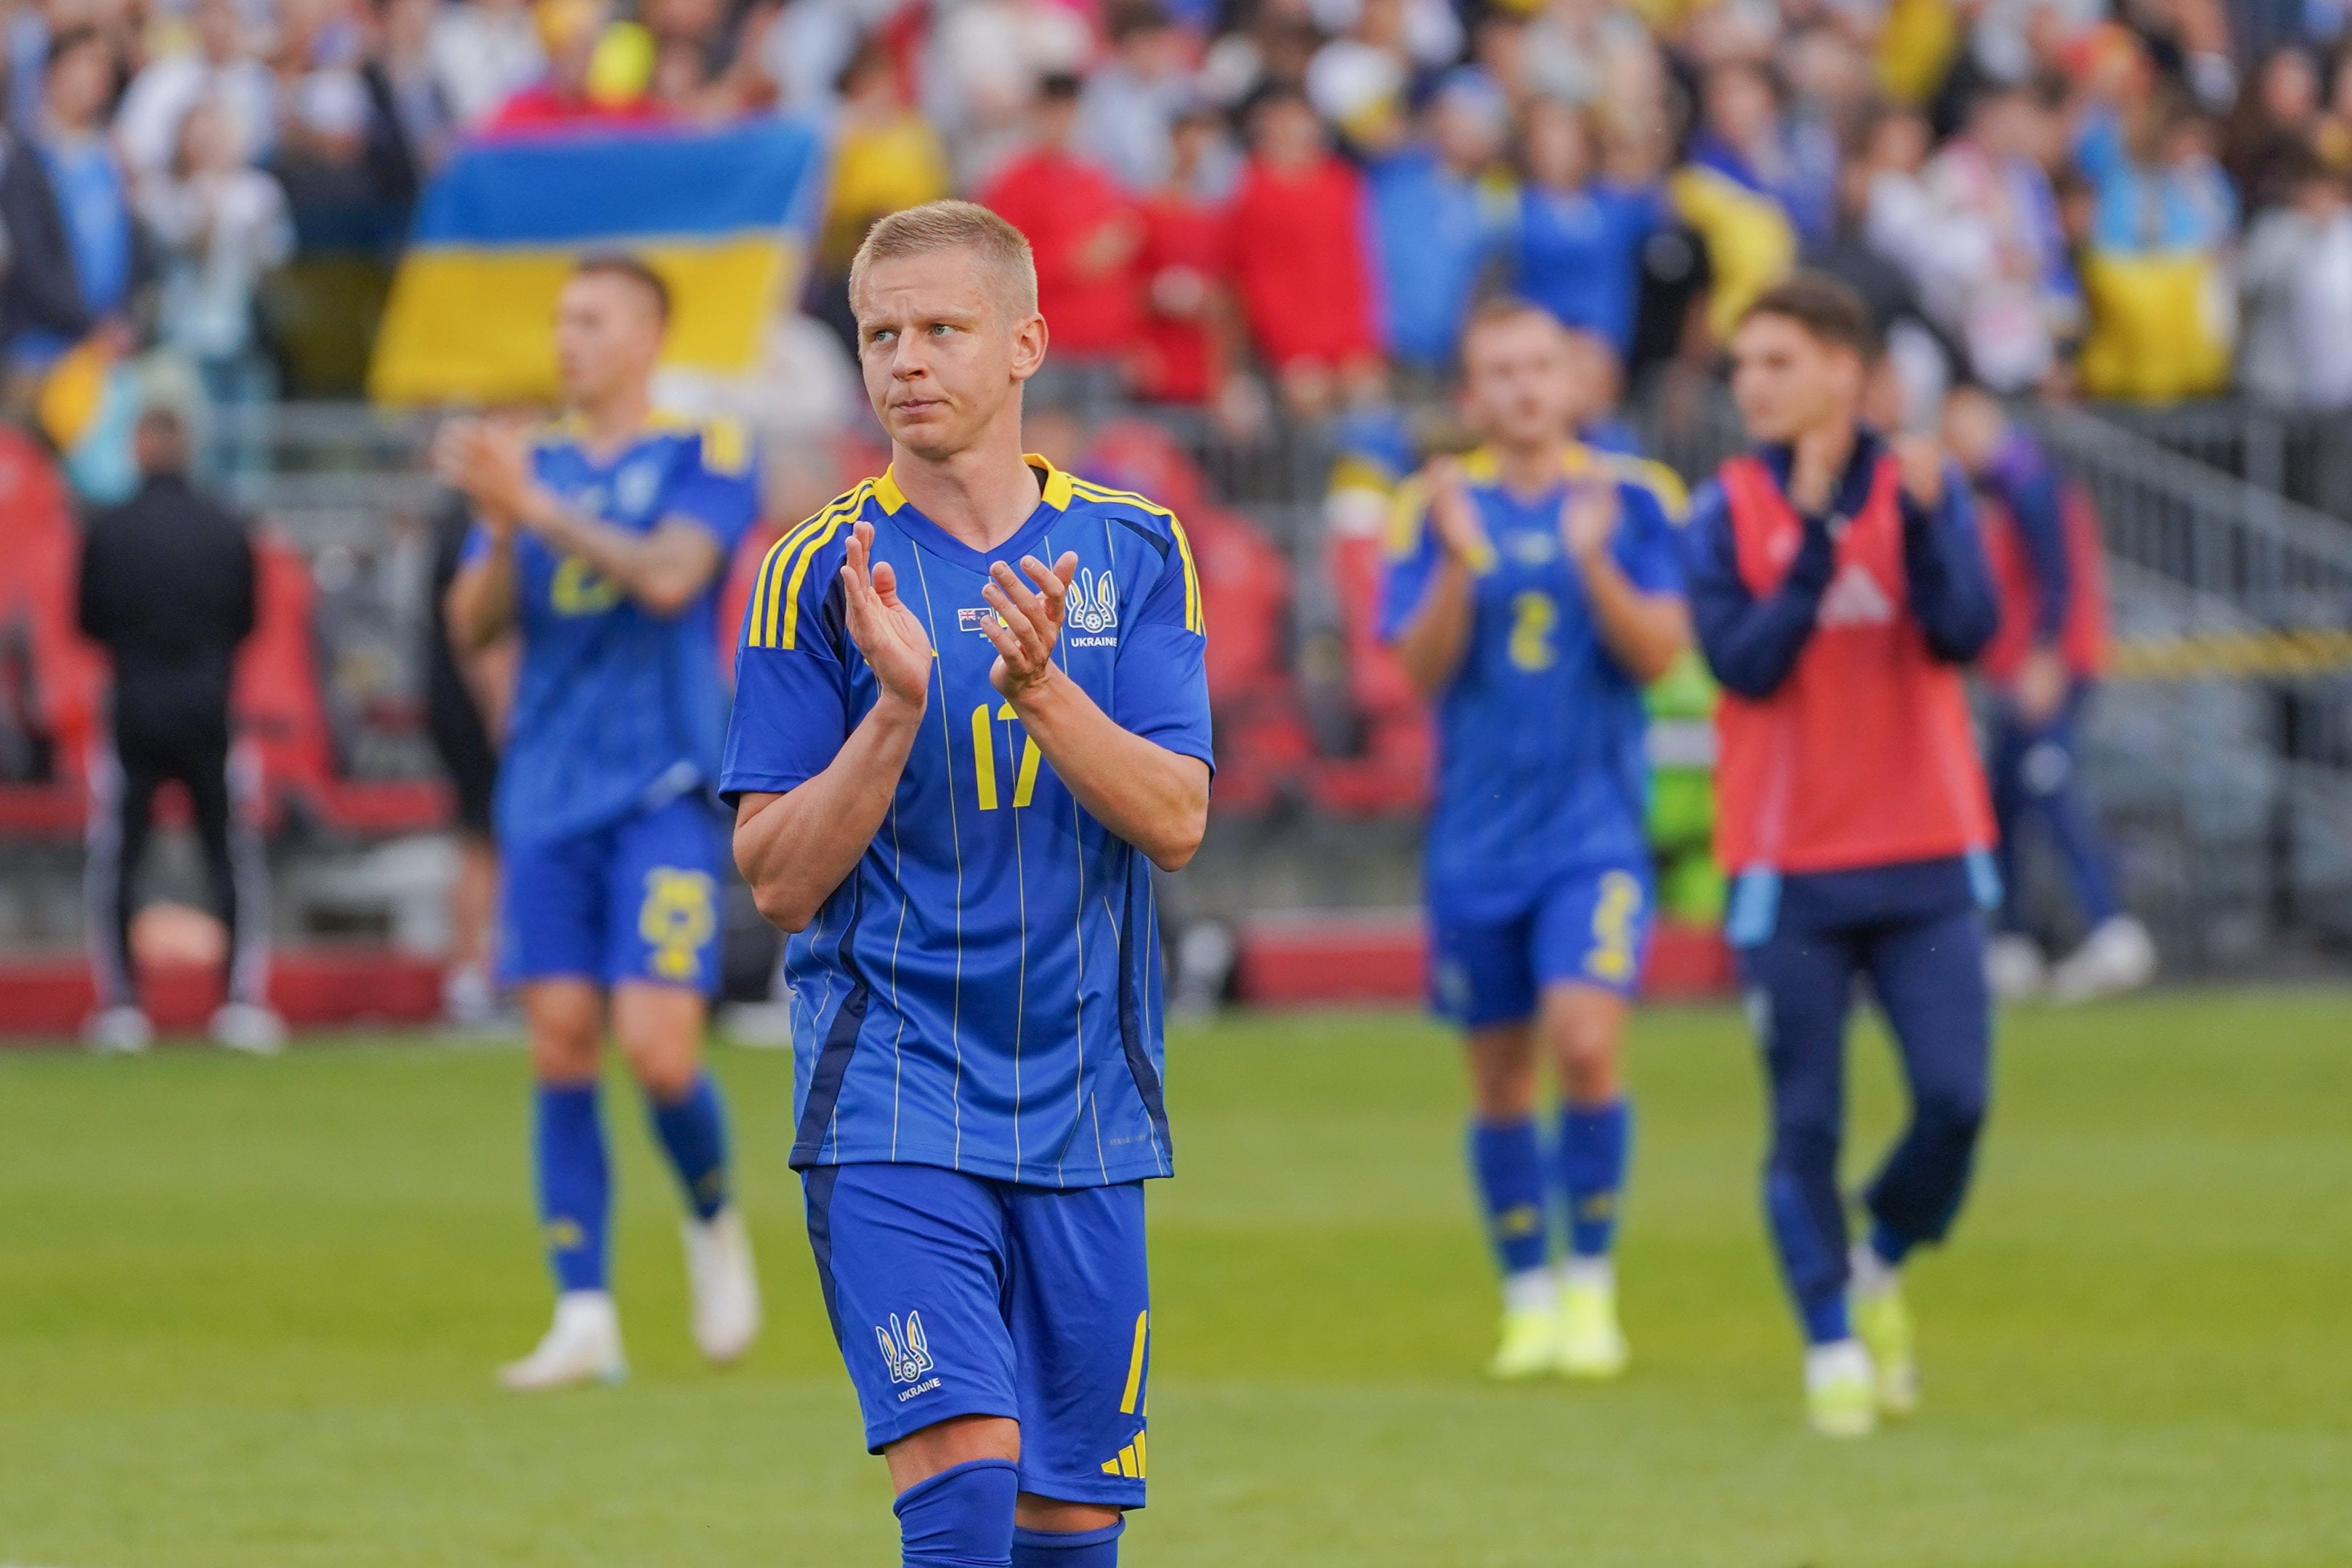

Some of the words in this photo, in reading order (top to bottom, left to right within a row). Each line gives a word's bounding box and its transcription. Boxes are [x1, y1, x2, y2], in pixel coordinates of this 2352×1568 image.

[1070, 637, 1118, 647] UKRAINE
[1507, 591, 1557, 672] 2
[898, 1378, 941, 1402] UKRAINE
